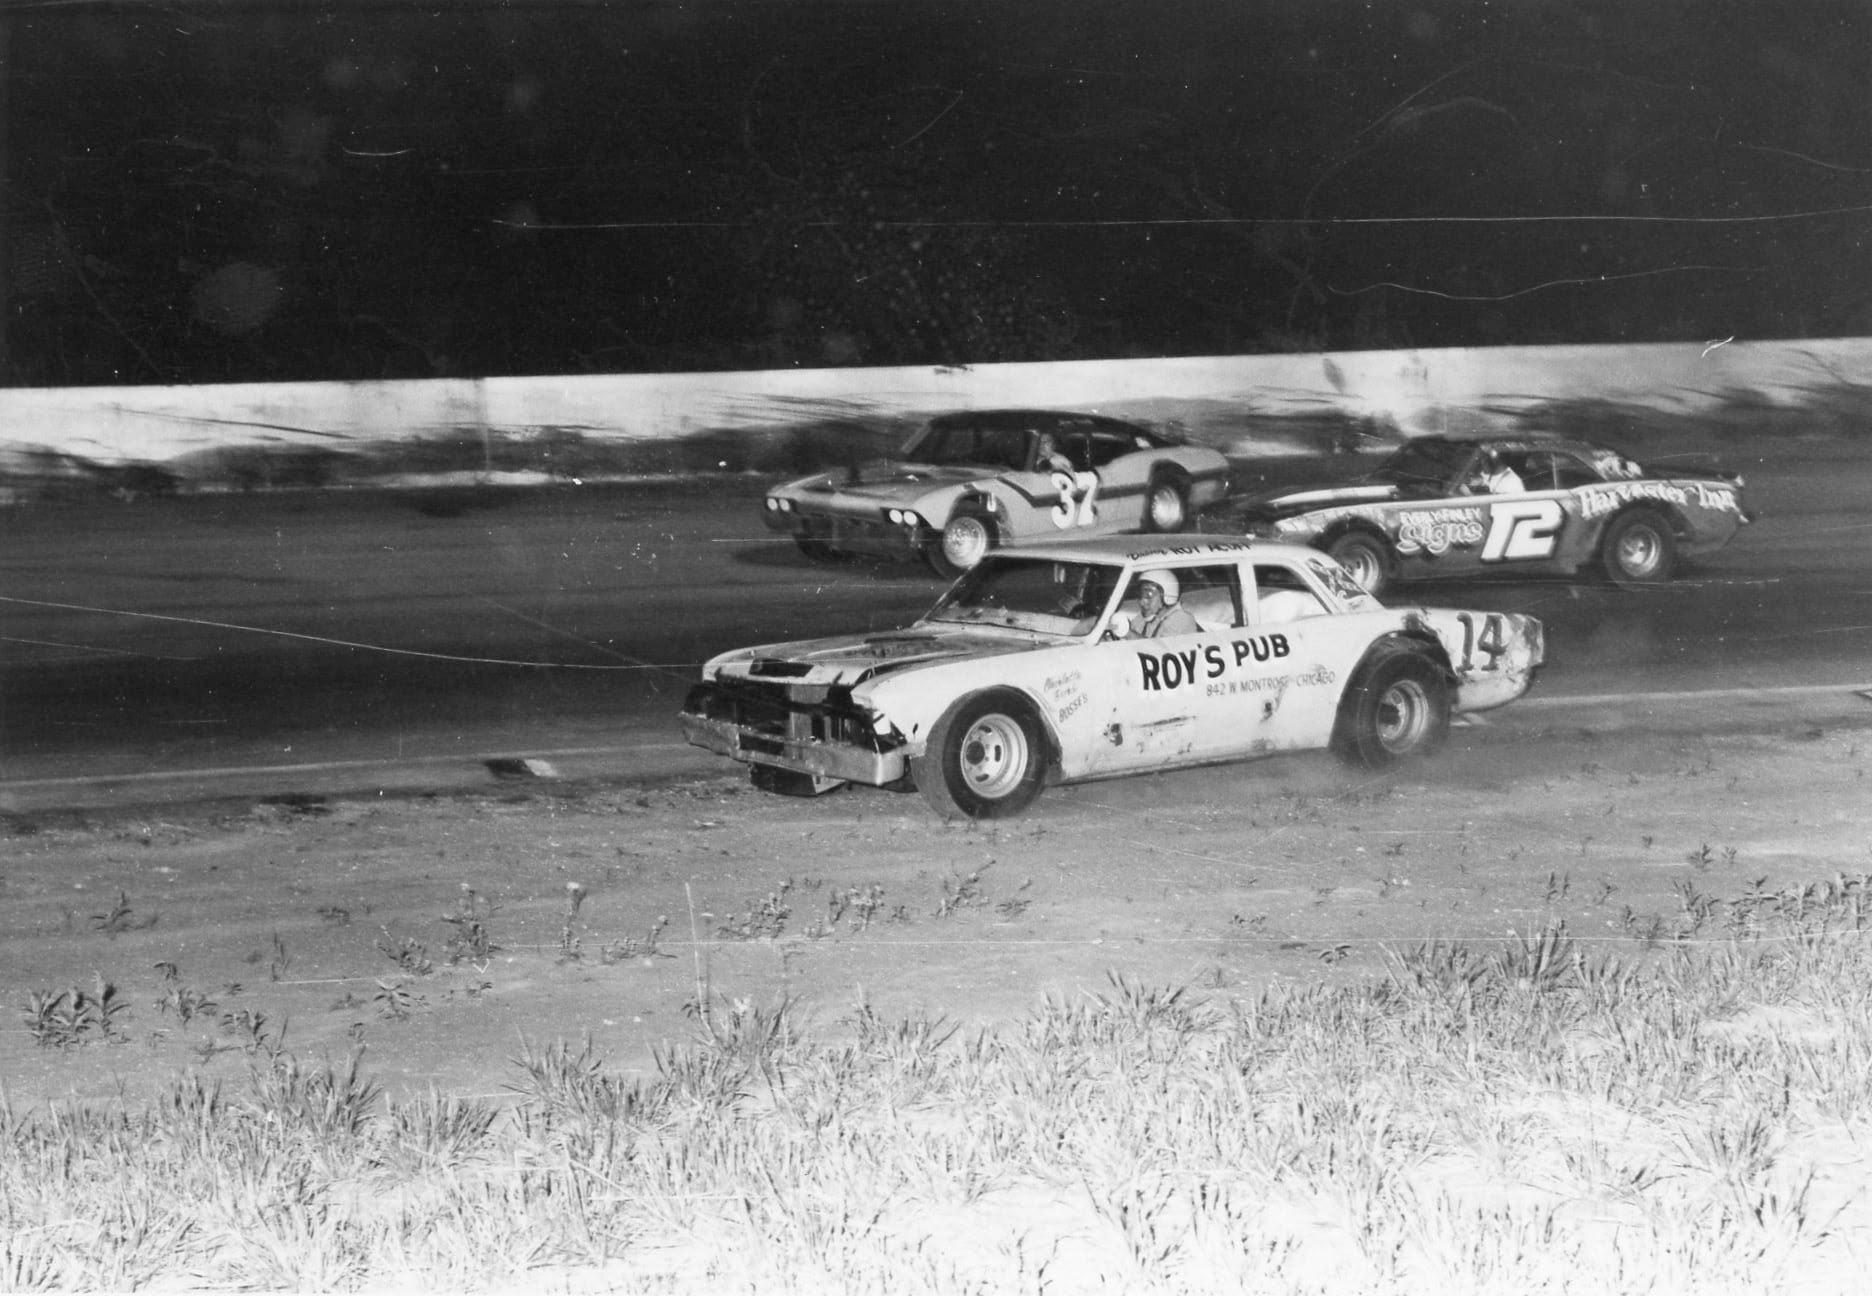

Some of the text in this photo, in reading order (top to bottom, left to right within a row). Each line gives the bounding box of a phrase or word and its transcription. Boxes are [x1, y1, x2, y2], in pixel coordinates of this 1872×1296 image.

[1051, 471, 1097, 529] 37
[1686, 482, 1741, 513] Inn
[1396, 521, 1484, 554] Signs
[1481, 500, 1562, 560] 12
[1137, 633, 1290, 691] ROY'S PUB
[1456, 612, 1508, 673] 14
[1206, 682, 1226, 696] 842
[1229, 681, 1237, 694] W
[1296, 670, 1336, 687] CHICAGO
